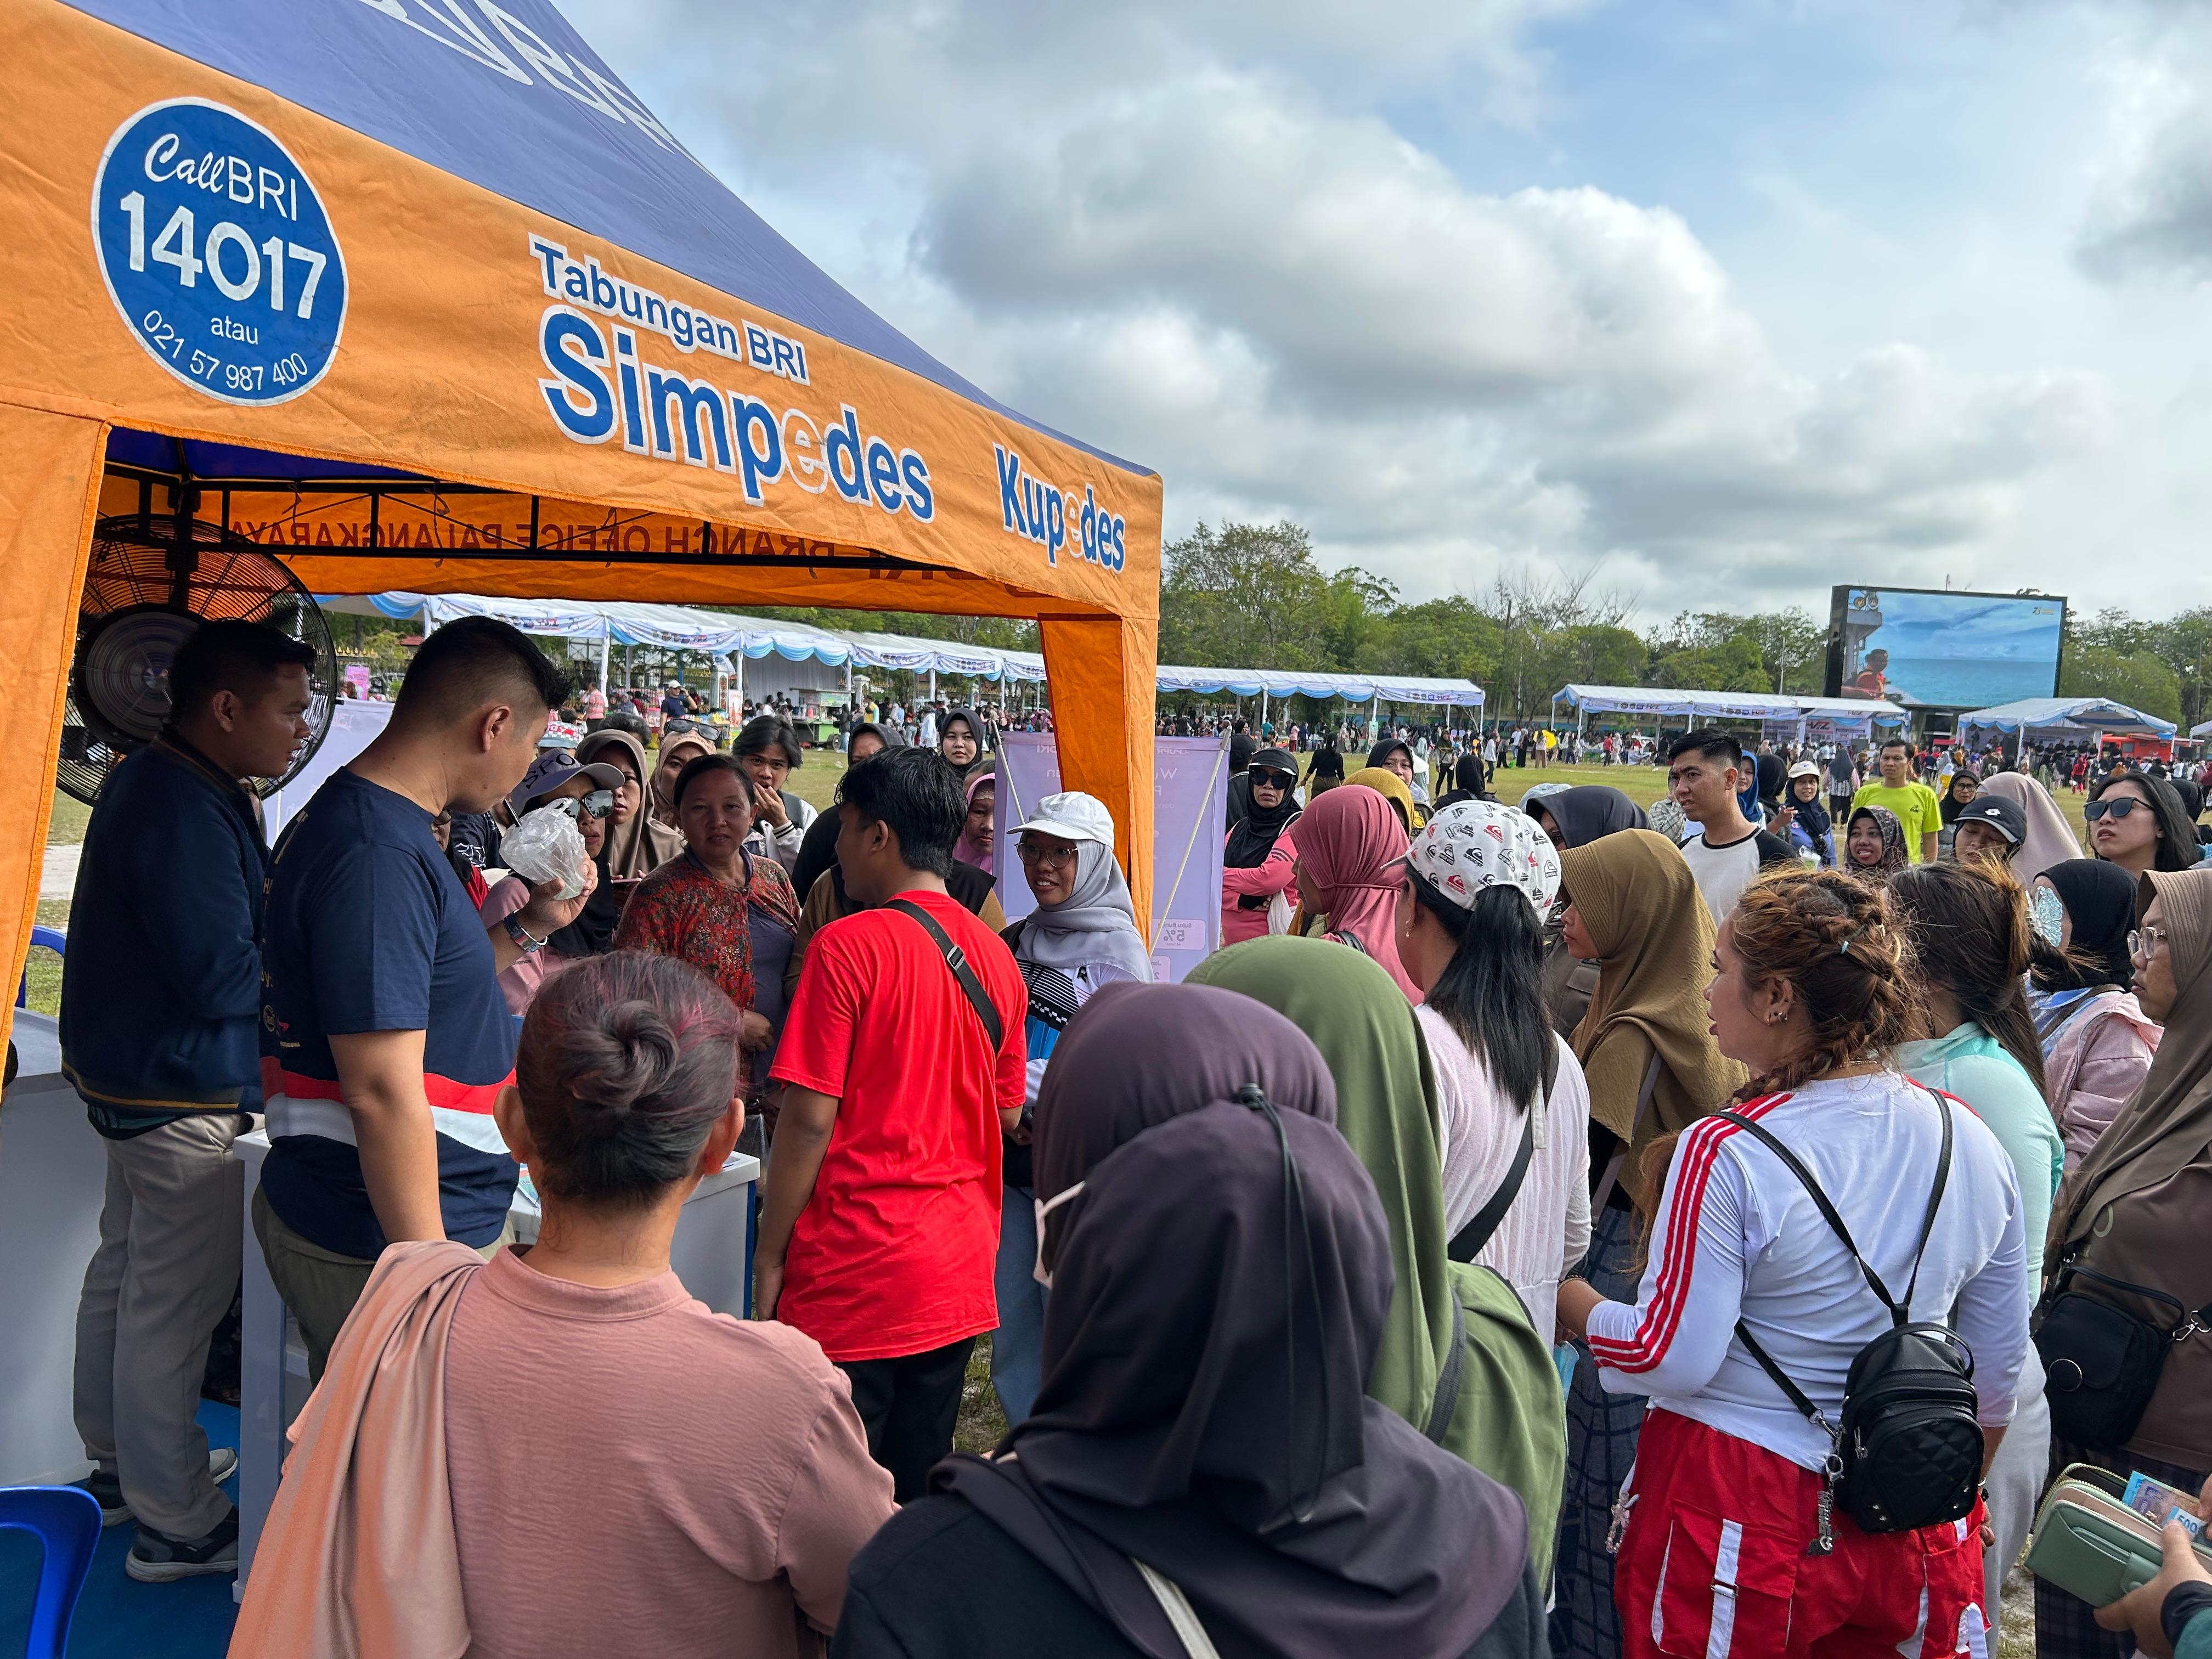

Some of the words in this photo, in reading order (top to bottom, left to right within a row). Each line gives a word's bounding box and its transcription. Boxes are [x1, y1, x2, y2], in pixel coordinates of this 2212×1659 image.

[121, 190, 326, 319] 14017
[531, 236, 741, 359] Tabungan
[744, 322, 808, 384] BRI
[144, 311, 184, 358] 021
[190, 349, 219, 380] 57
[225, 364, 263, 391] 987
[273, 353, 307, 386] 400
[210, 315, 258, 345] atau
[540, 307, 934, 522] Simpedes
[994, 444, 1125, 573] Kupedes
